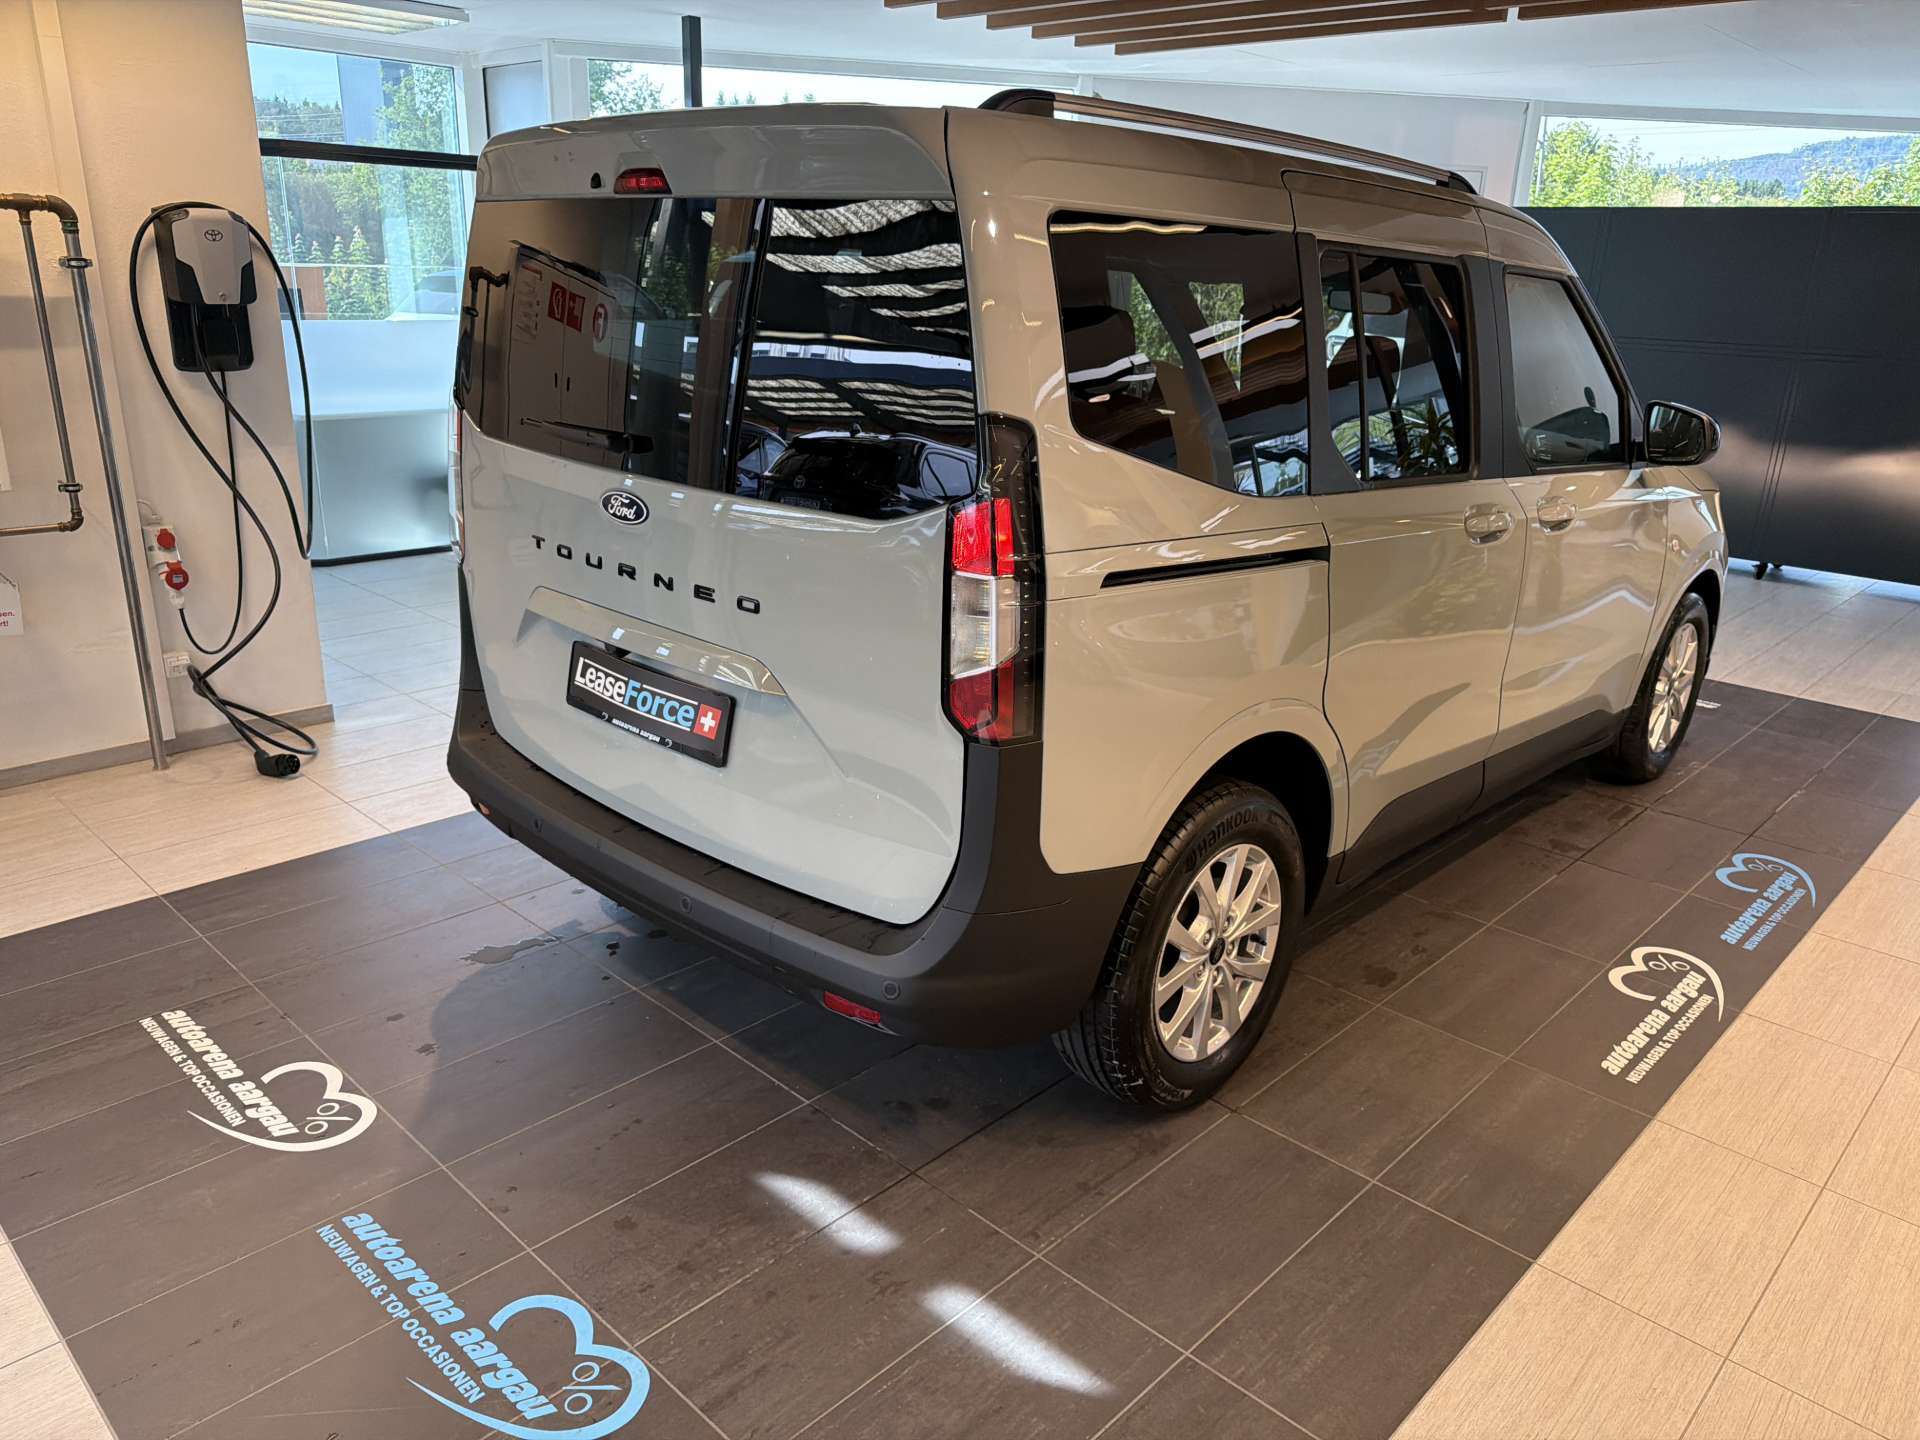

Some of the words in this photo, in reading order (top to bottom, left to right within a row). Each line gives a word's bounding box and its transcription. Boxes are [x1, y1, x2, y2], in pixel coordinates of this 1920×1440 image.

[608, 495, 637, 519] Ford
[532, 534, 760, 615] TOURNEO
[574, 656, 695, 729] LeaseForce
[139, 1017, 183, 1059] NEUWAGEN
[1600, 1009, 1671, 1076] autoarena
[1661, 972, 1707, 1013] aargau
[1625, 1046, 1667, 1084] NEUWAGEN
[1662, 1028, 1682, 1042] TOP
[161, 1009, 244, 1080] autoarena
[228, 1080, 300, 1137] aargau
[175, 1054, 187, 1064] &
[179, 1059, 201, 1076] TOP
[192, 1074, 246, 1127] OCCASIONEN
[316, 1224, 381, 1288] NEUWAGEN
[371, 1283, 384, 1298] &
[379, 1292, 411, 1319] TOP
[401, 1315, 485, 1404] OCCASIONEN
[341, 1212, 465, 1326] autoarena
[450, 1328, 557, 1420] aargau
